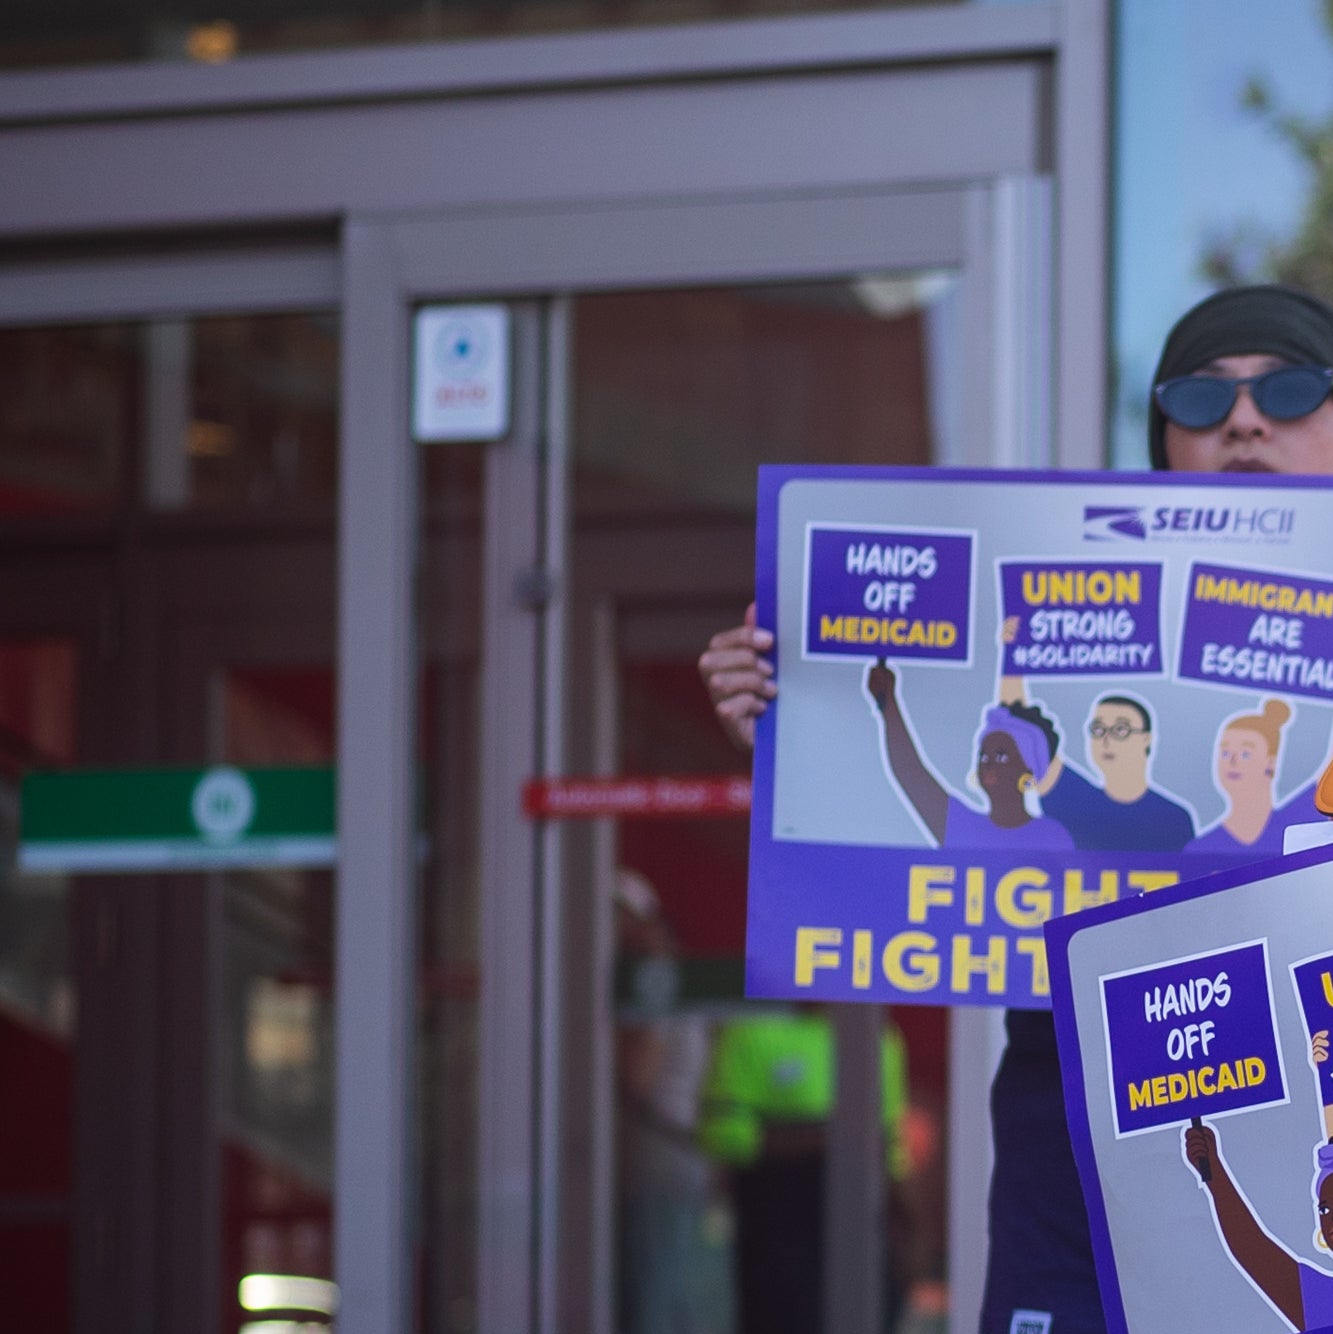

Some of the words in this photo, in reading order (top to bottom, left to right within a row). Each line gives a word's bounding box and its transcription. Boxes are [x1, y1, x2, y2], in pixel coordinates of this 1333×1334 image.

[846, 543, 937, 579] HANDS
[863, 581, 915, 612] OFF
[1022, 570, 1141, 605] UNION
[819, 616, 958, 648] MEDICAID
[1029, 609, 1135, 642] STRONG
[1248, 613, 1303, 650] ARE
[1144, 971, 1232, 1023] HANDS
[1166, 1020, 1216, 1061] OFF
[1128, 1056, 1267, 1111] MEDICAID
